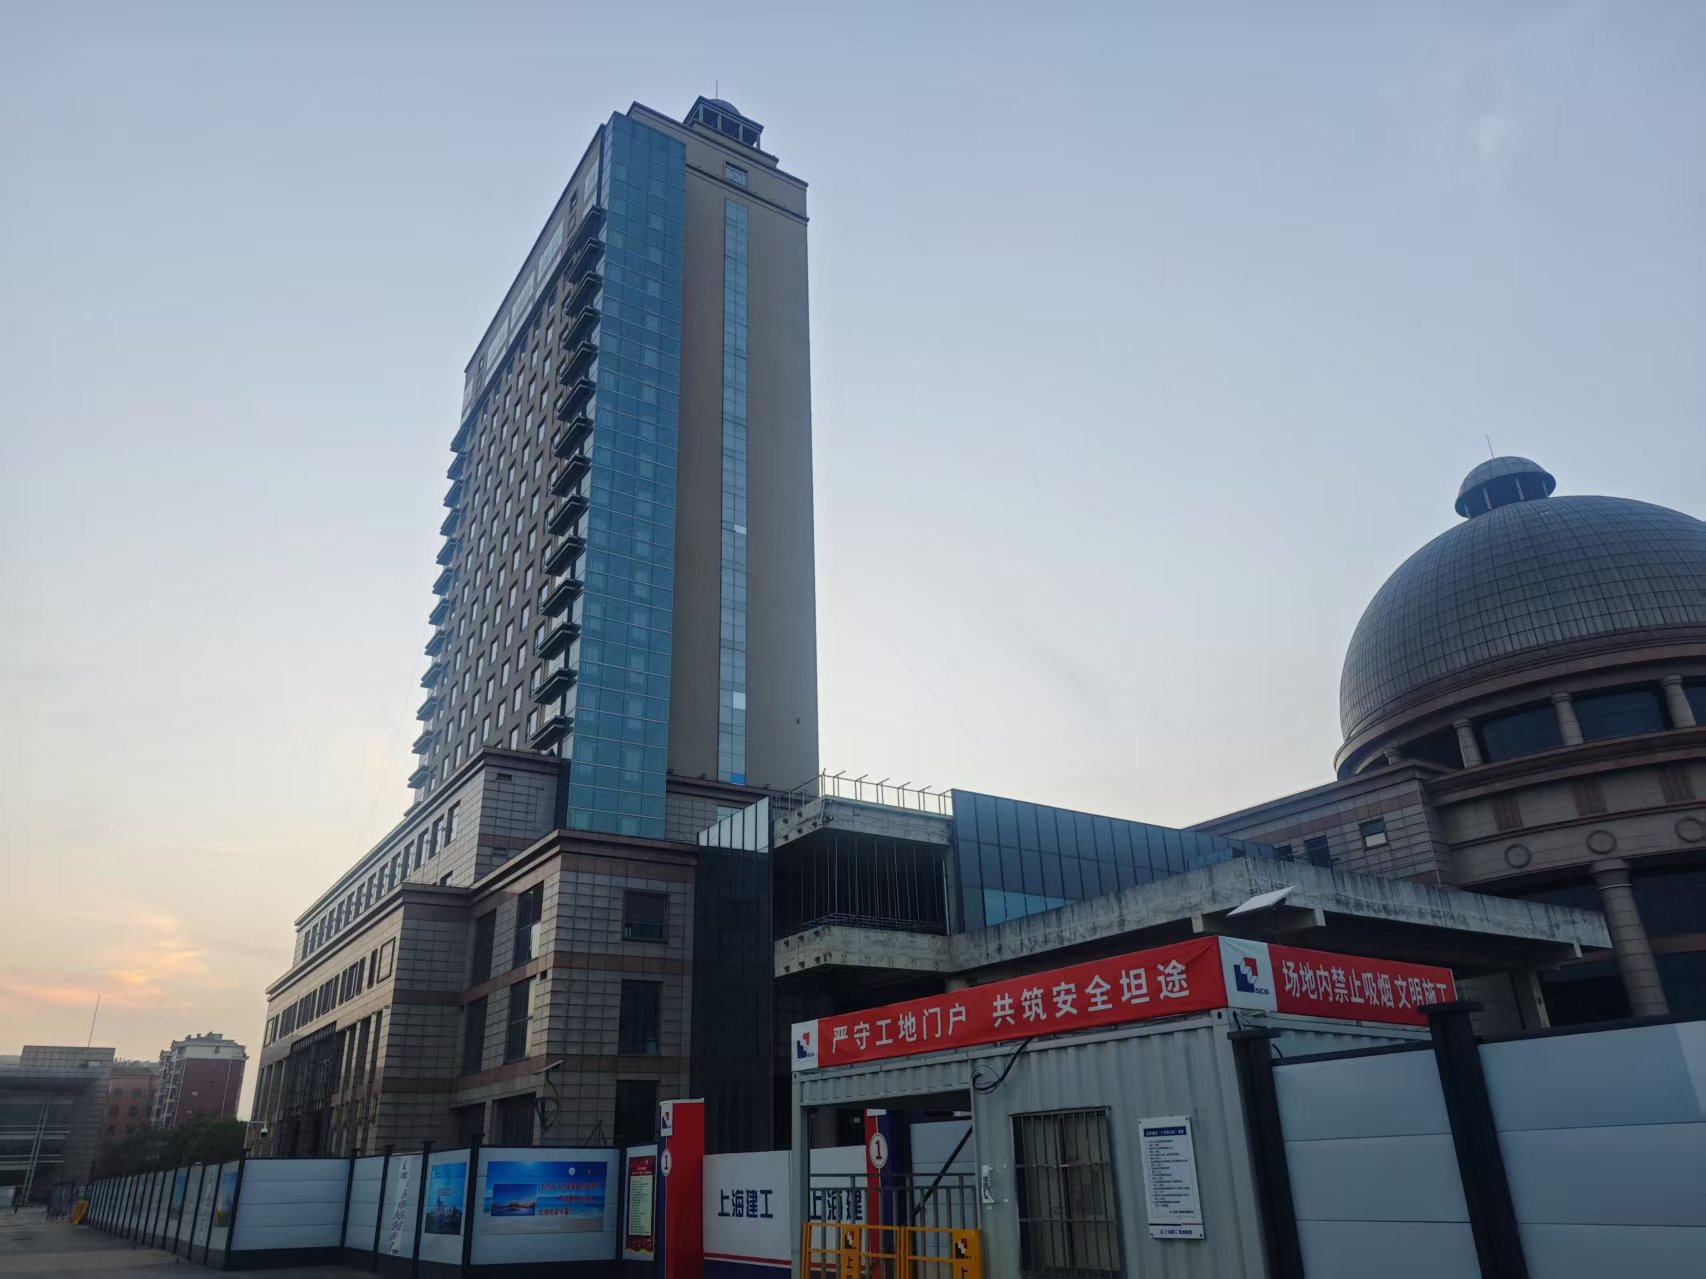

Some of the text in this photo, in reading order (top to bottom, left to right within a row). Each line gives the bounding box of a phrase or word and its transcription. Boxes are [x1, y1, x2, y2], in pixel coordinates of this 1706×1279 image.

[1282, 960, 1448, 1008] 场地内禁止吸烟 文明施工
[831, 959, 1190, 1054] 严守工地门户 共筑安全坦途
[875, 1140, 882, 1160] 1
[718, 1189, 774, 1218] 上海建工
